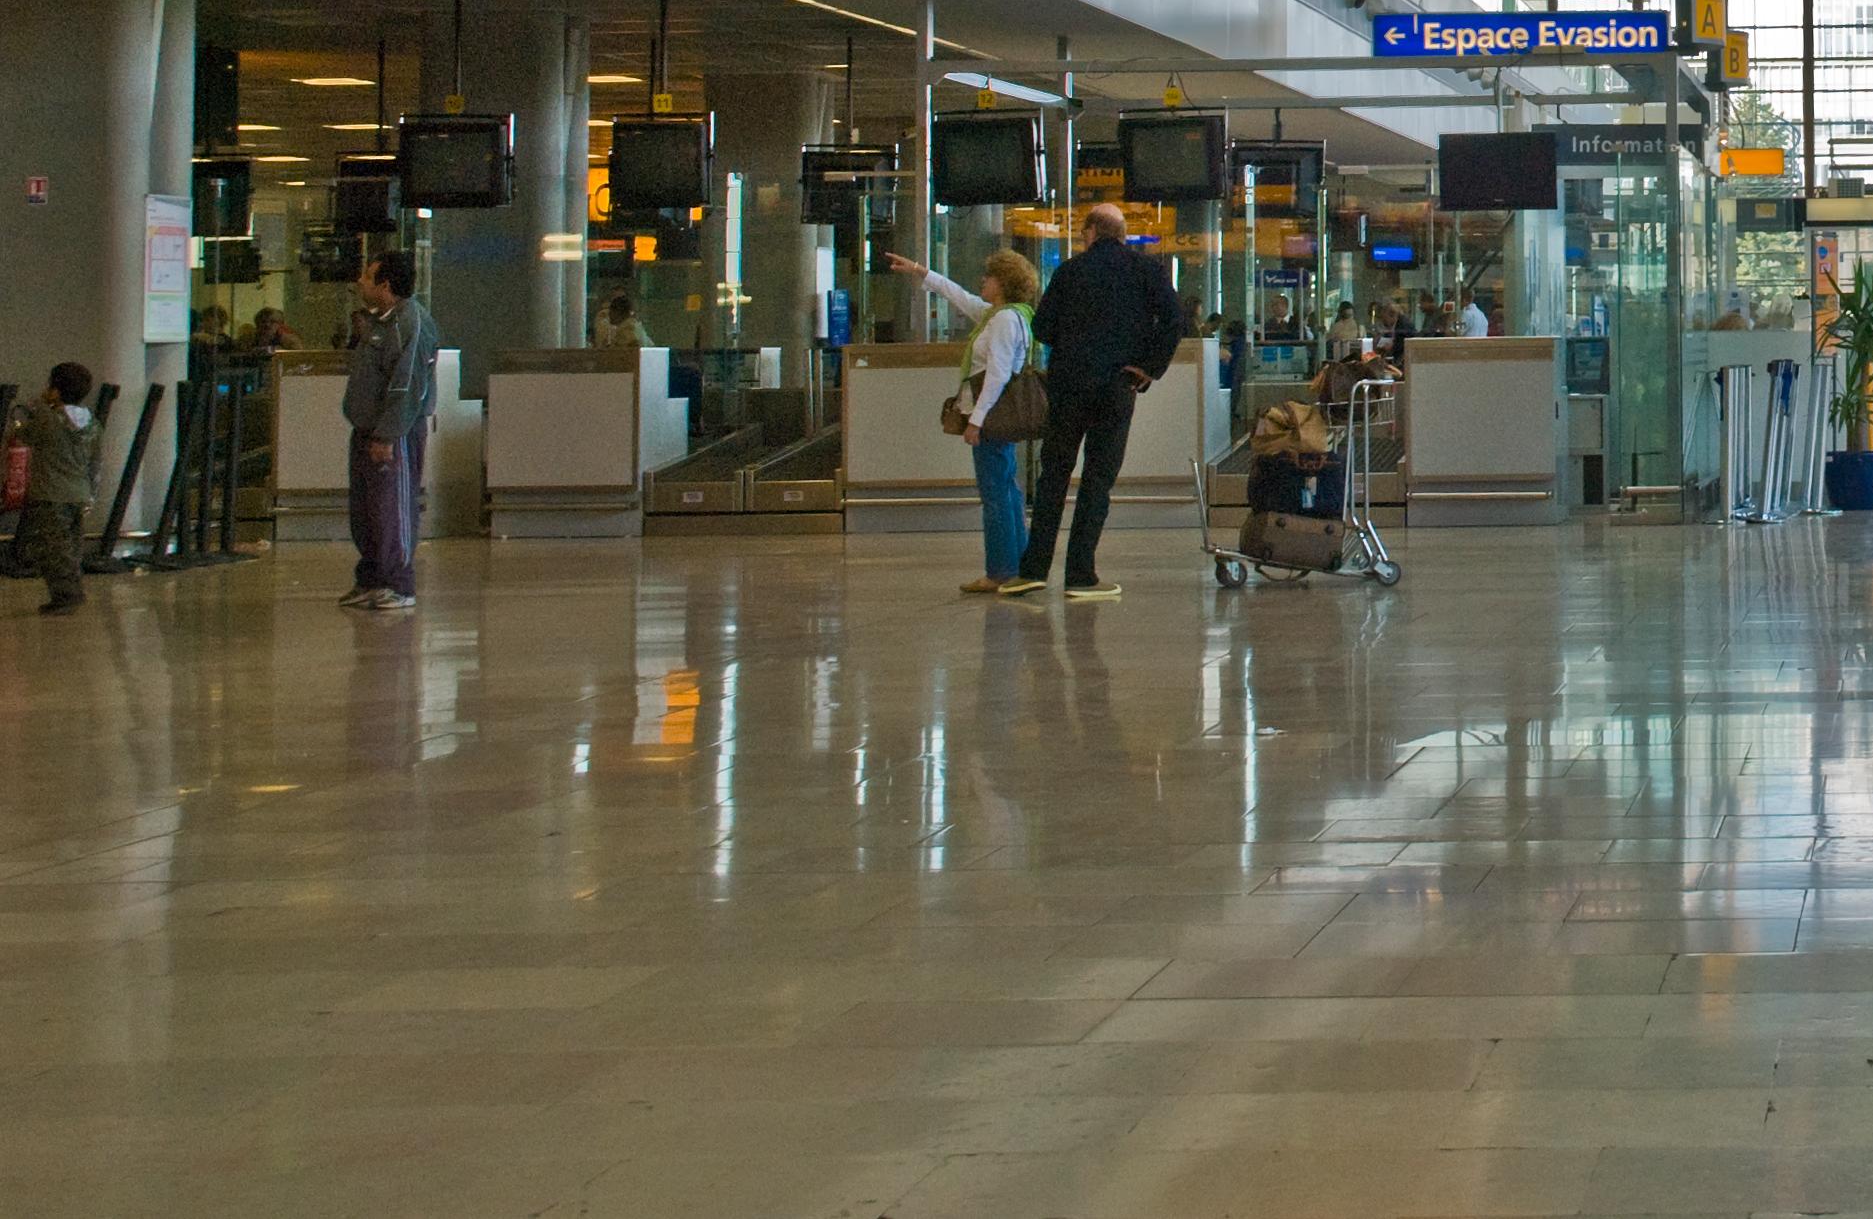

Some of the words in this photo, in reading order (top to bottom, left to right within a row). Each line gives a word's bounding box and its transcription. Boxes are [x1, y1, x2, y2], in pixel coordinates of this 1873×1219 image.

[1702, 3, 1717, 34] A
[1423, 23, 1529, 56] Espace
[1538, 19, 1658, 49] Evasion
[1729, 47, 1740, 73] B
[1572, 135, 1696, 153] Infomatn
